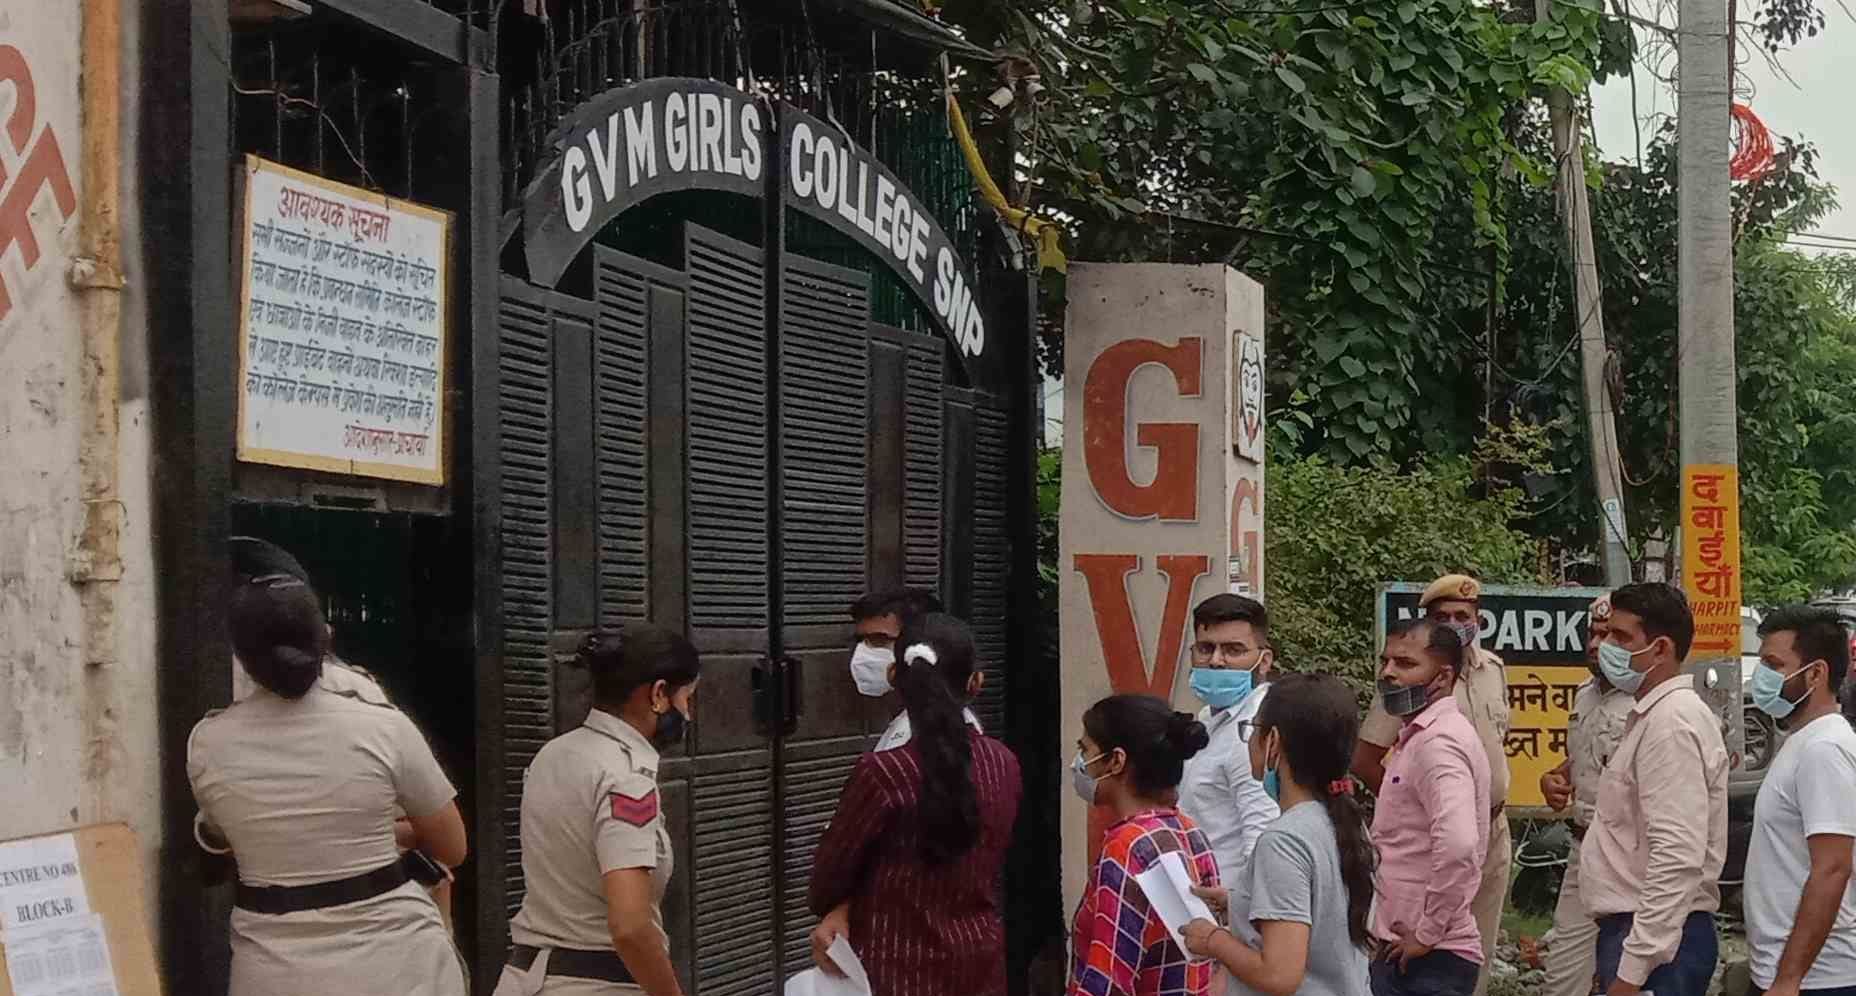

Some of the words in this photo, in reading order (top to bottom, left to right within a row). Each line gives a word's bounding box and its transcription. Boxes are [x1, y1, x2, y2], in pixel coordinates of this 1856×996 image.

[278, 186, 345, 231] आवश्यक
[562, 100, 657, 232] GVM
[665, 92, 762, 181] GIRLS
[791, 123, 931, 285] COLLEGE
[933, 247, 985, 358] SNP
[1475, 609, 1593, 651] PARK
[0, 867, 41, 888] ENTRE
